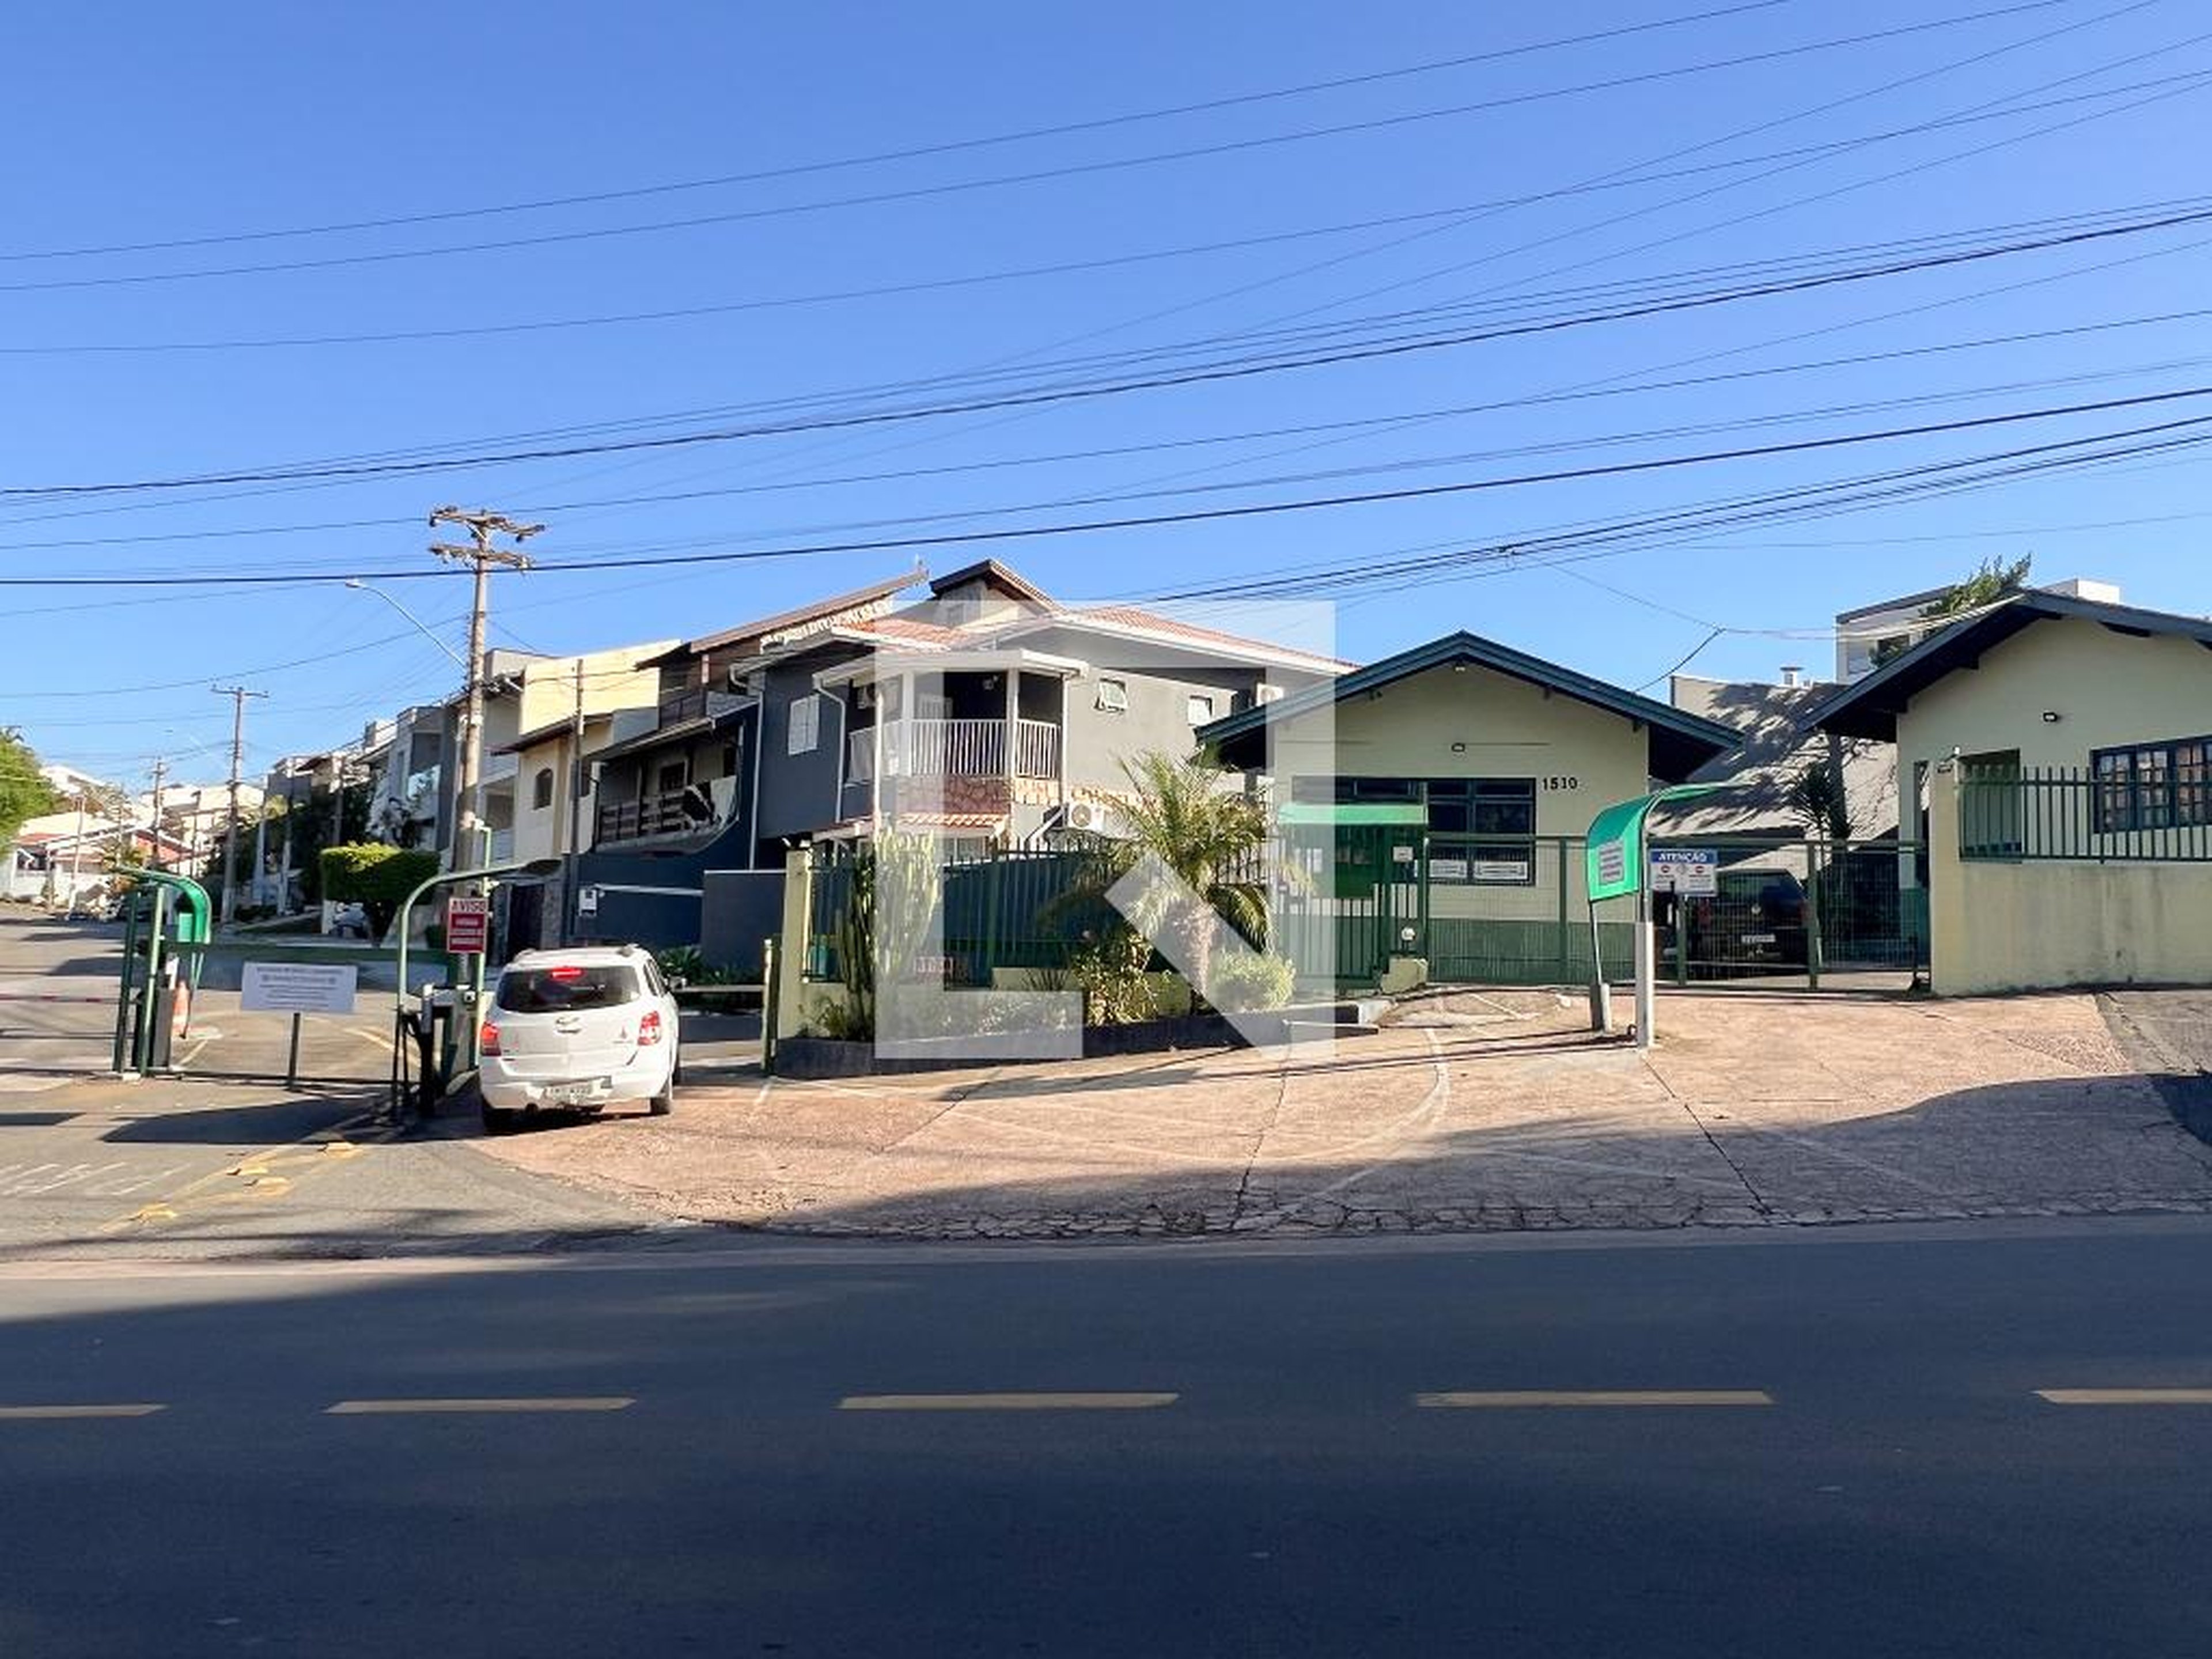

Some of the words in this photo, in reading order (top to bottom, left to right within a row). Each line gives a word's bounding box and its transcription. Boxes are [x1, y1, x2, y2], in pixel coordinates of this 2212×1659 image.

[1543, 777, 1578, 791] 1510
[1658, 851, 1707, 863] ATENÇÃO
[451, 900, 486, 912] AVISO
